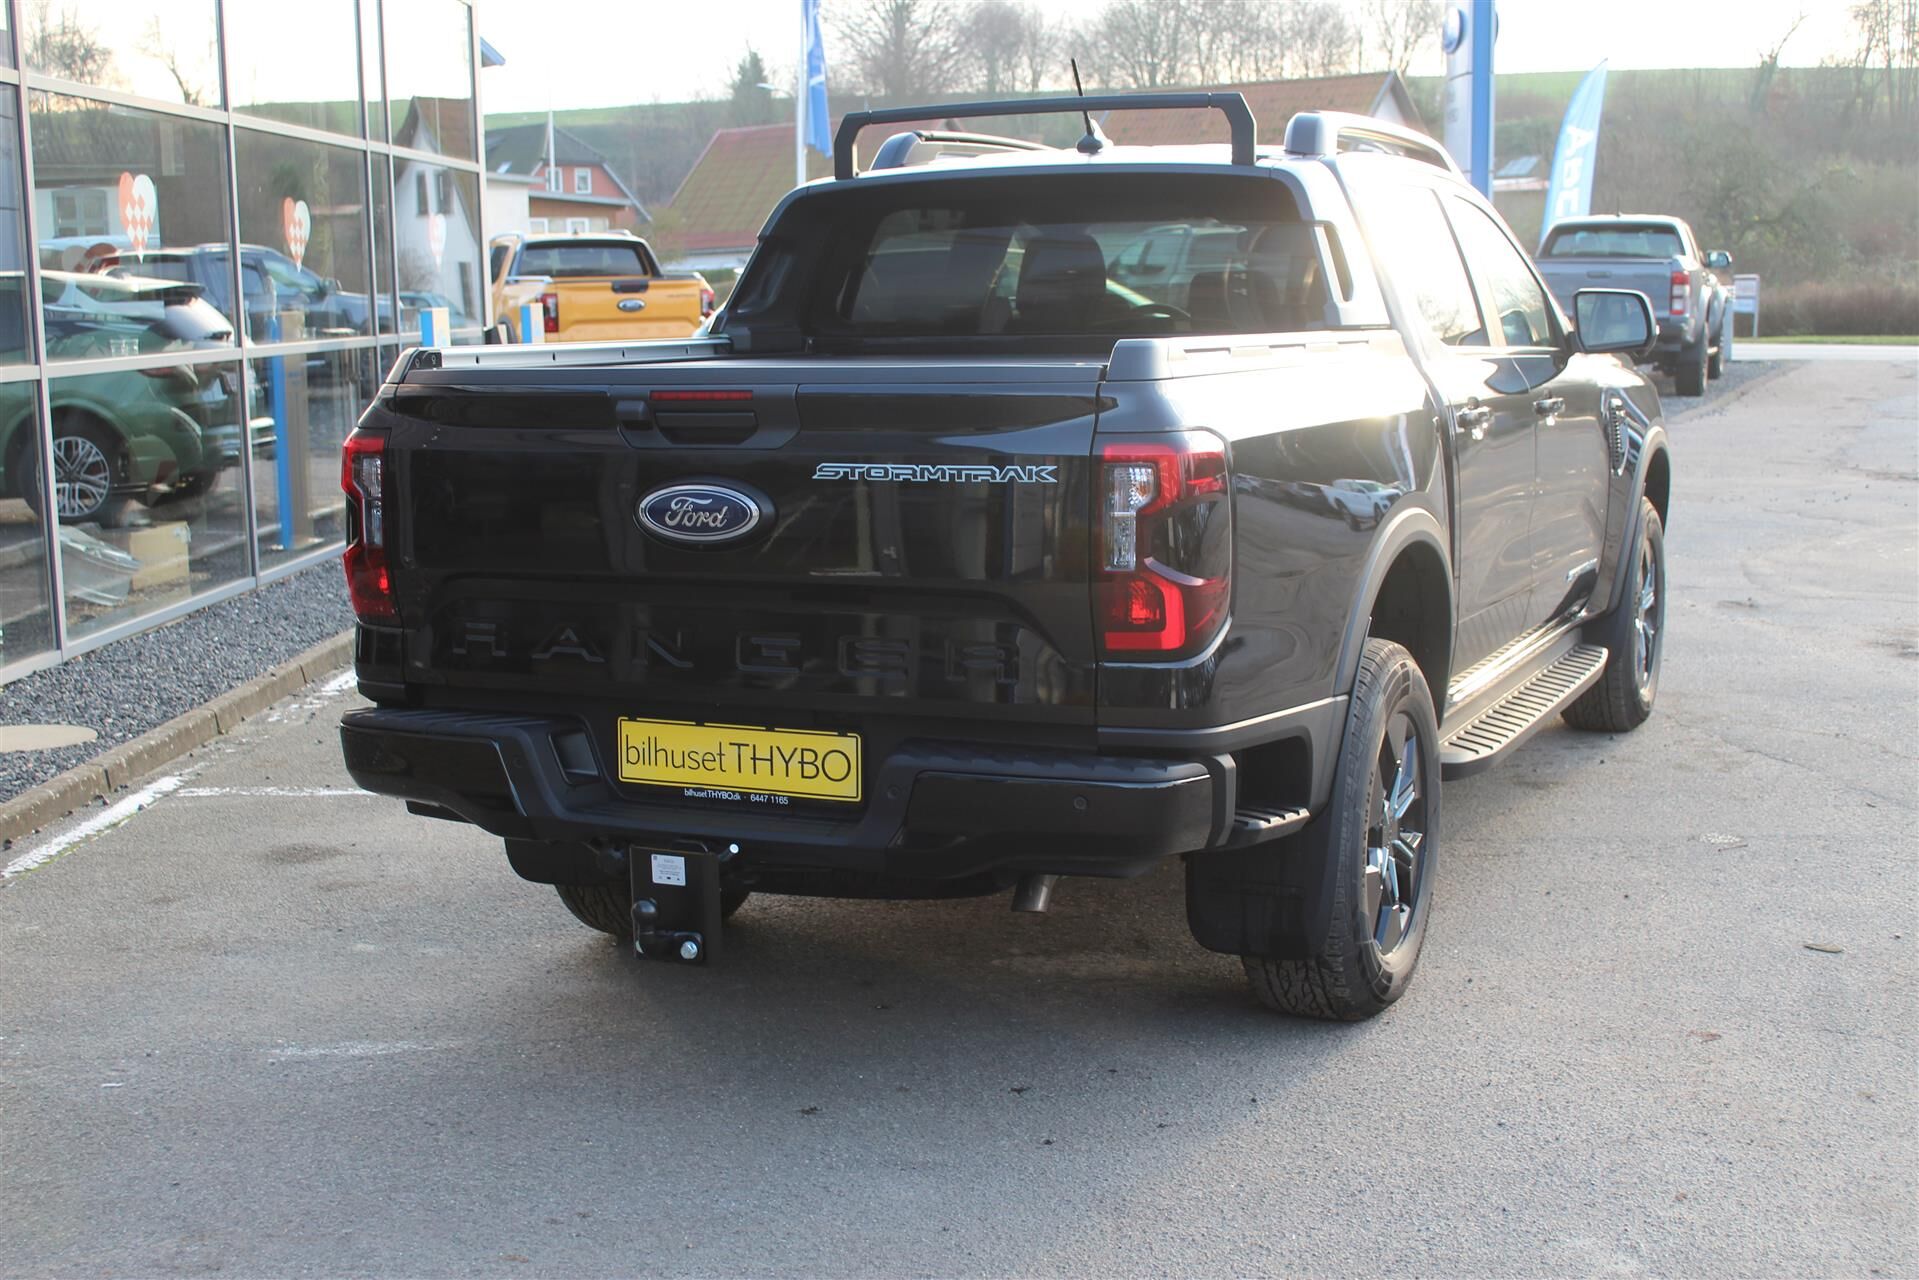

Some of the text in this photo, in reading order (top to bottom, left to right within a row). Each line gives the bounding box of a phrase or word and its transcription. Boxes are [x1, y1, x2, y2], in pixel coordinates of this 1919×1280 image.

[812, 462, 1058, 483] STORMTRAK
[664, 496, 729, 528] Ford
[452, 620, 1021, 685] RANGER
[750, 793, 769, 803] 6447
[771, 795, 789, 805] 1165
